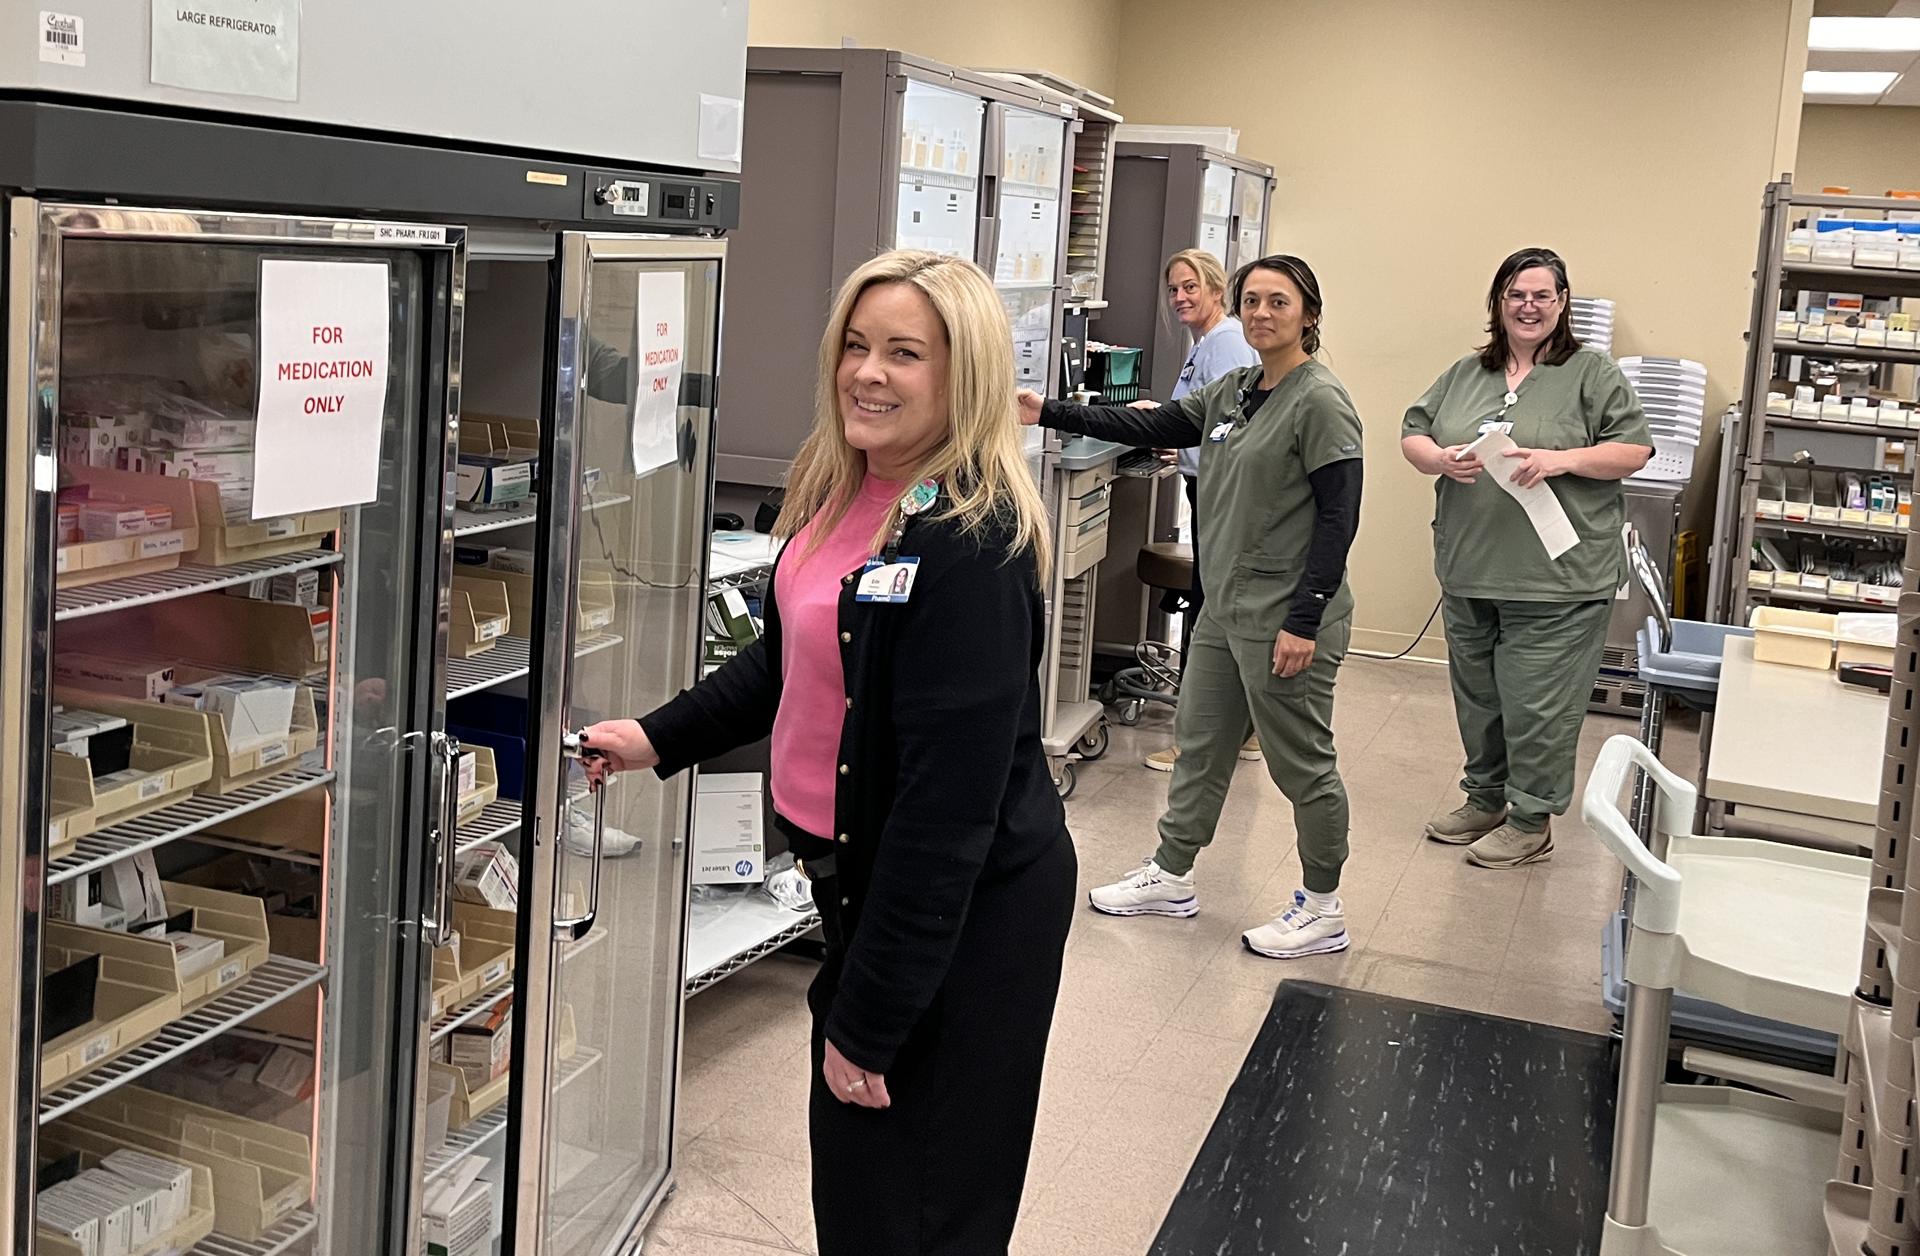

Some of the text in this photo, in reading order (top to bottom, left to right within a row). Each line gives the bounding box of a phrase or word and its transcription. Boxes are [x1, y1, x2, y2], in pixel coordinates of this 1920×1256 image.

[176, 9, 277, 37] LARGE REFRIGERATOR
[380, 227, 393, 238] SHC
[312, 326, 343, 344] FOR
[656, 322, 669, 337] FOR
[644, 347, 679, 367] MEDICATION
[278, 360, 373, 381] MEDICATION
[652, 376, 669, 393] ONLY
[304, 395, 345, 414] ONLY
[701, 859, 753, 877] hp LaserJet
